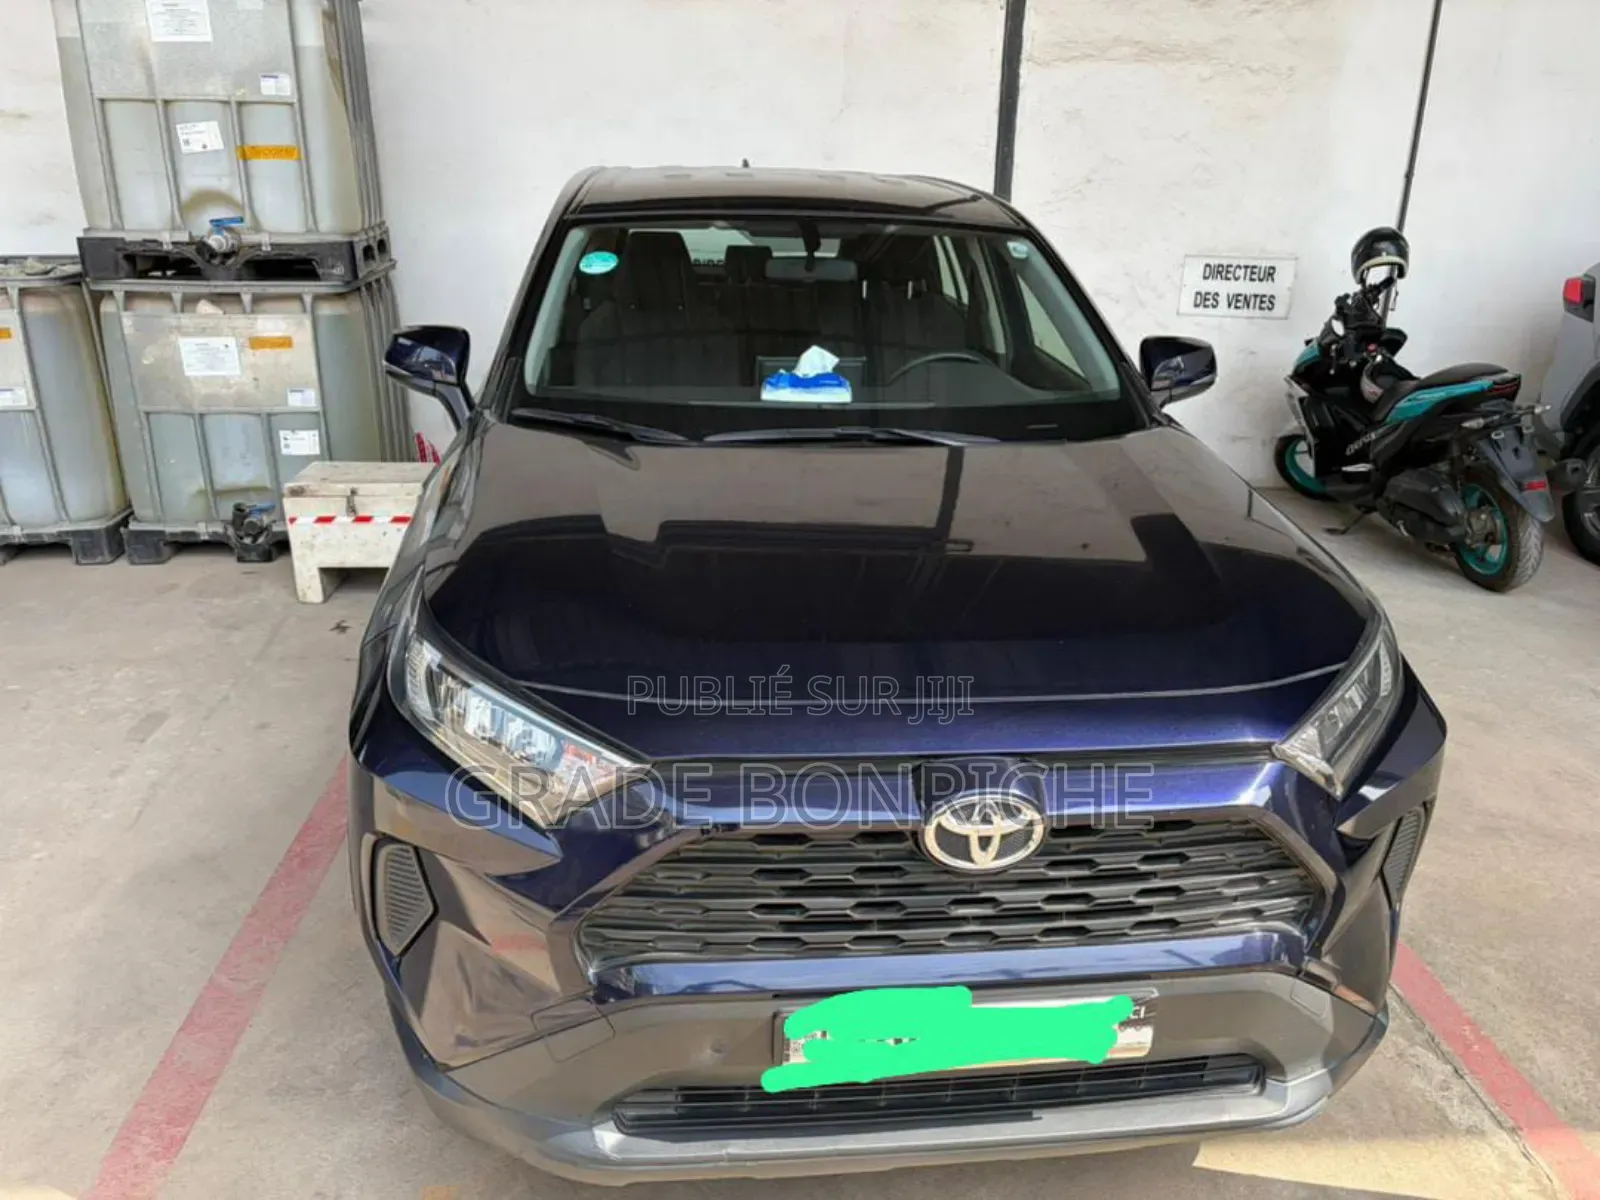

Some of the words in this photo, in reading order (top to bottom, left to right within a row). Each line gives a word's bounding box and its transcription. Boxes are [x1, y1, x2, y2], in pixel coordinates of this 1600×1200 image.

[1203, 263, 1276, 282] DIRECTEUR
[1193, 291, 1219, 309] DES
[1226, 292, 1276, 311] VENTES
